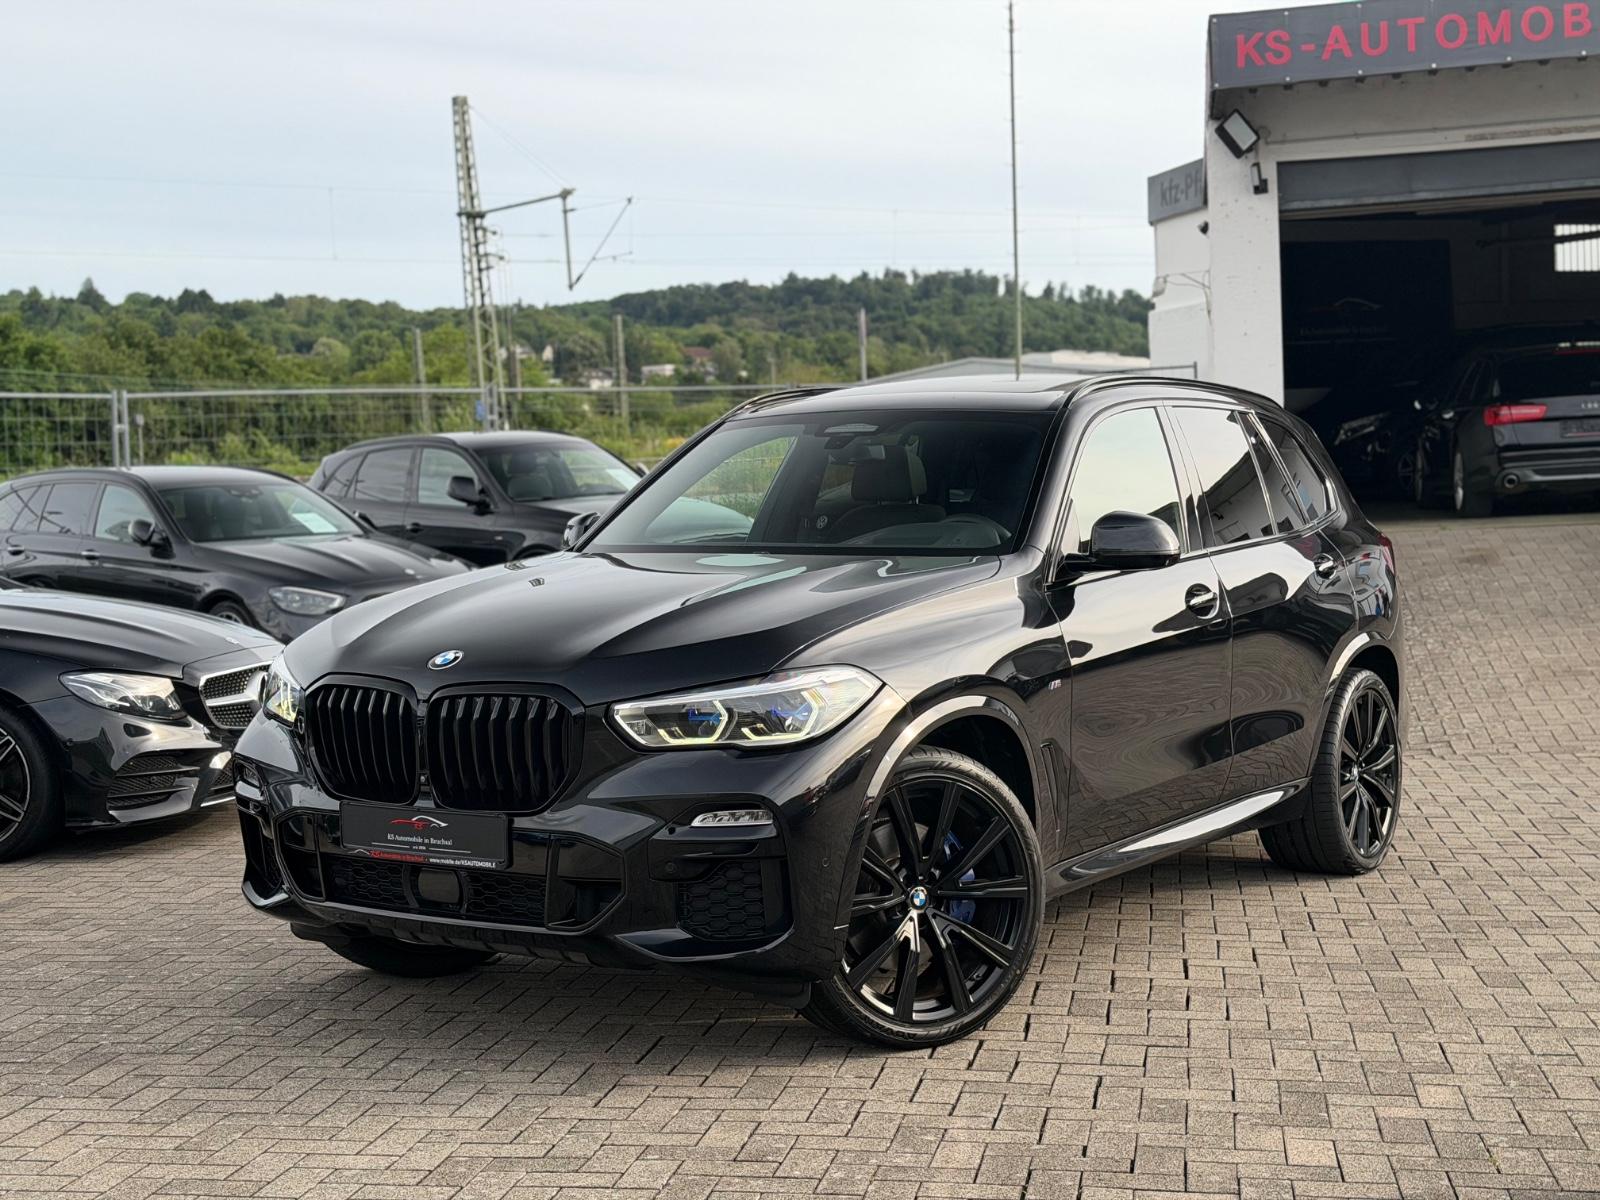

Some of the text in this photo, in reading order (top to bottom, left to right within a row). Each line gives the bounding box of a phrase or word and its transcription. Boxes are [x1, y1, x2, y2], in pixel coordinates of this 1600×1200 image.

[1235, 2, 1592, 69] KS-AUTOMOB
[1160, 169, 1204, 209] kfz-Pf
[395, 834, 423, 843] Automobile
[424, 836, 430, 844] in
